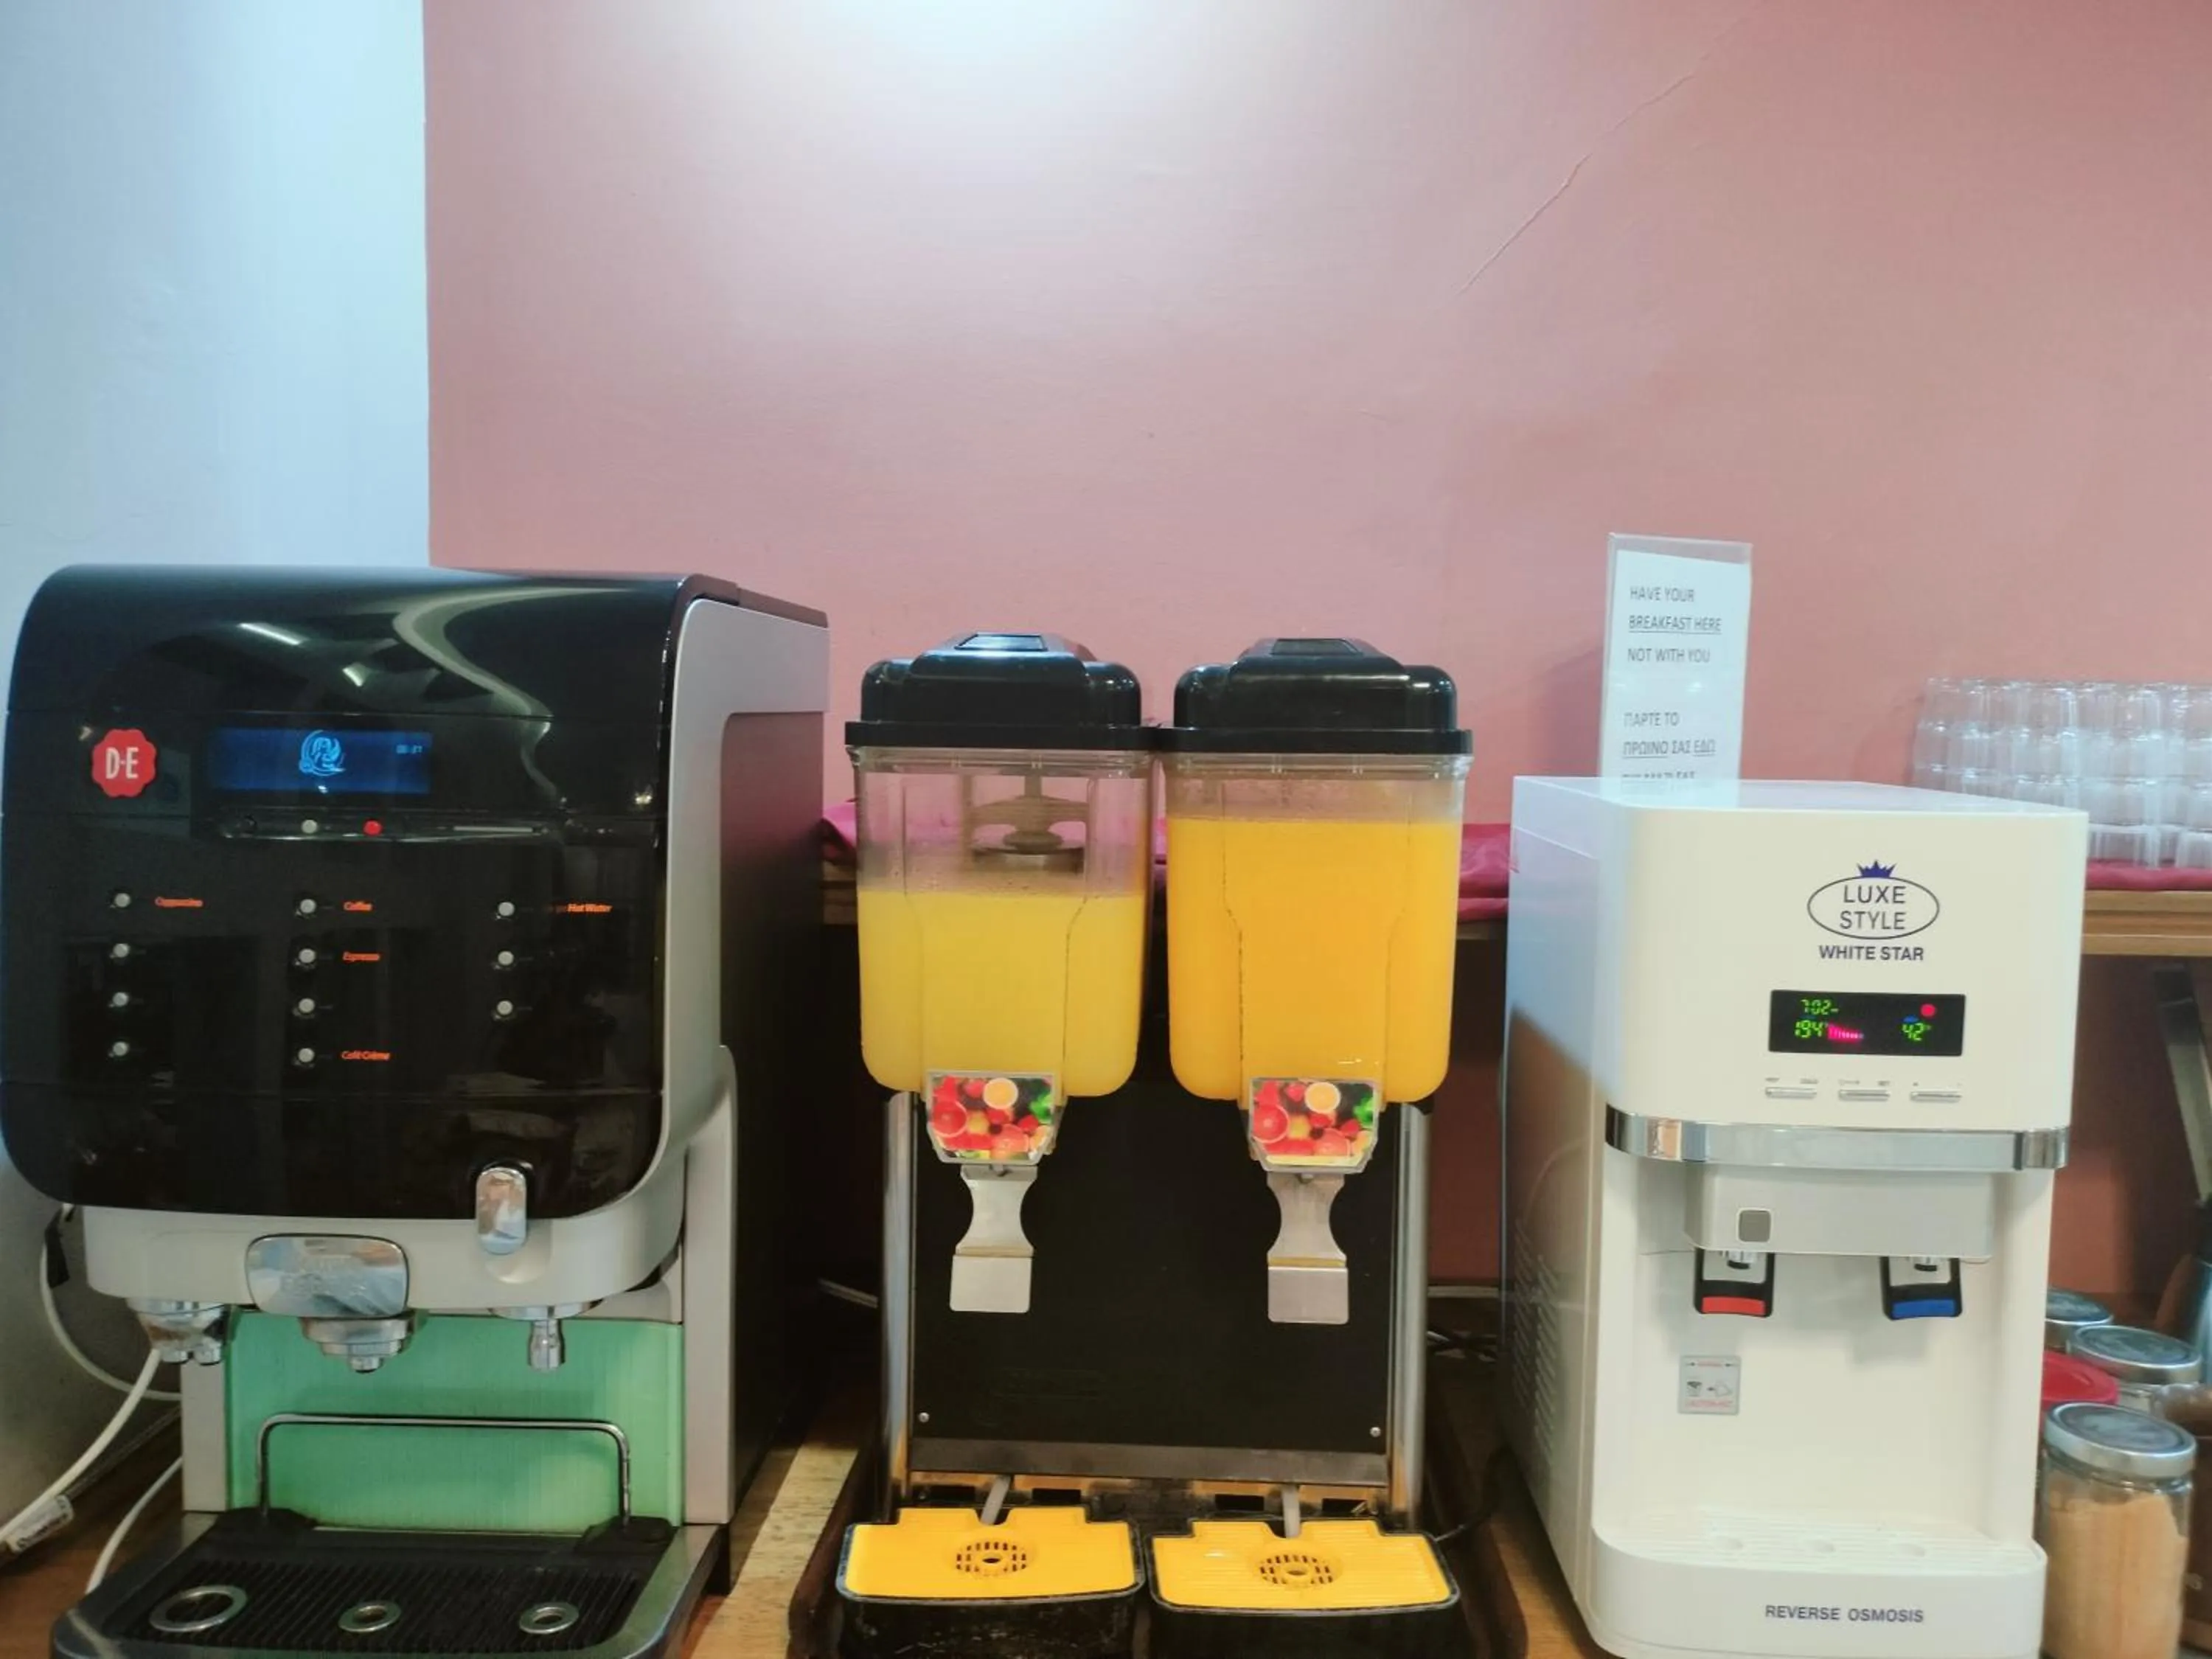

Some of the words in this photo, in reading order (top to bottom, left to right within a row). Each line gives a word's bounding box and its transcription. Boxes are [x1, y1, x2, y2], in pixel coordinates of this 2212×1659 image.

[1630, 586, 1661, 601] HAVE
[1664, 587, 1694, 602] YOUR
[1629, 615, 1692, 630] BREAKFAST
[1694, 616, 1722, 632] HERE
[1627, 647, 1652, 662] NOT
[1655, 648, 1685, 662] WITH
[1688, 648, 1711, 663] YOU
[1843, 885, 1907, 904] LUXE
[1840, 910, 1907, 930] STYLE
[1819, 945, 1877, 960] WHITE
[1879, 945, 1924, 961] STAR
[1765, 1604, 1841, 1621] REVERSE
[1848, 1607, 1924, 1623] OSMOSIS
